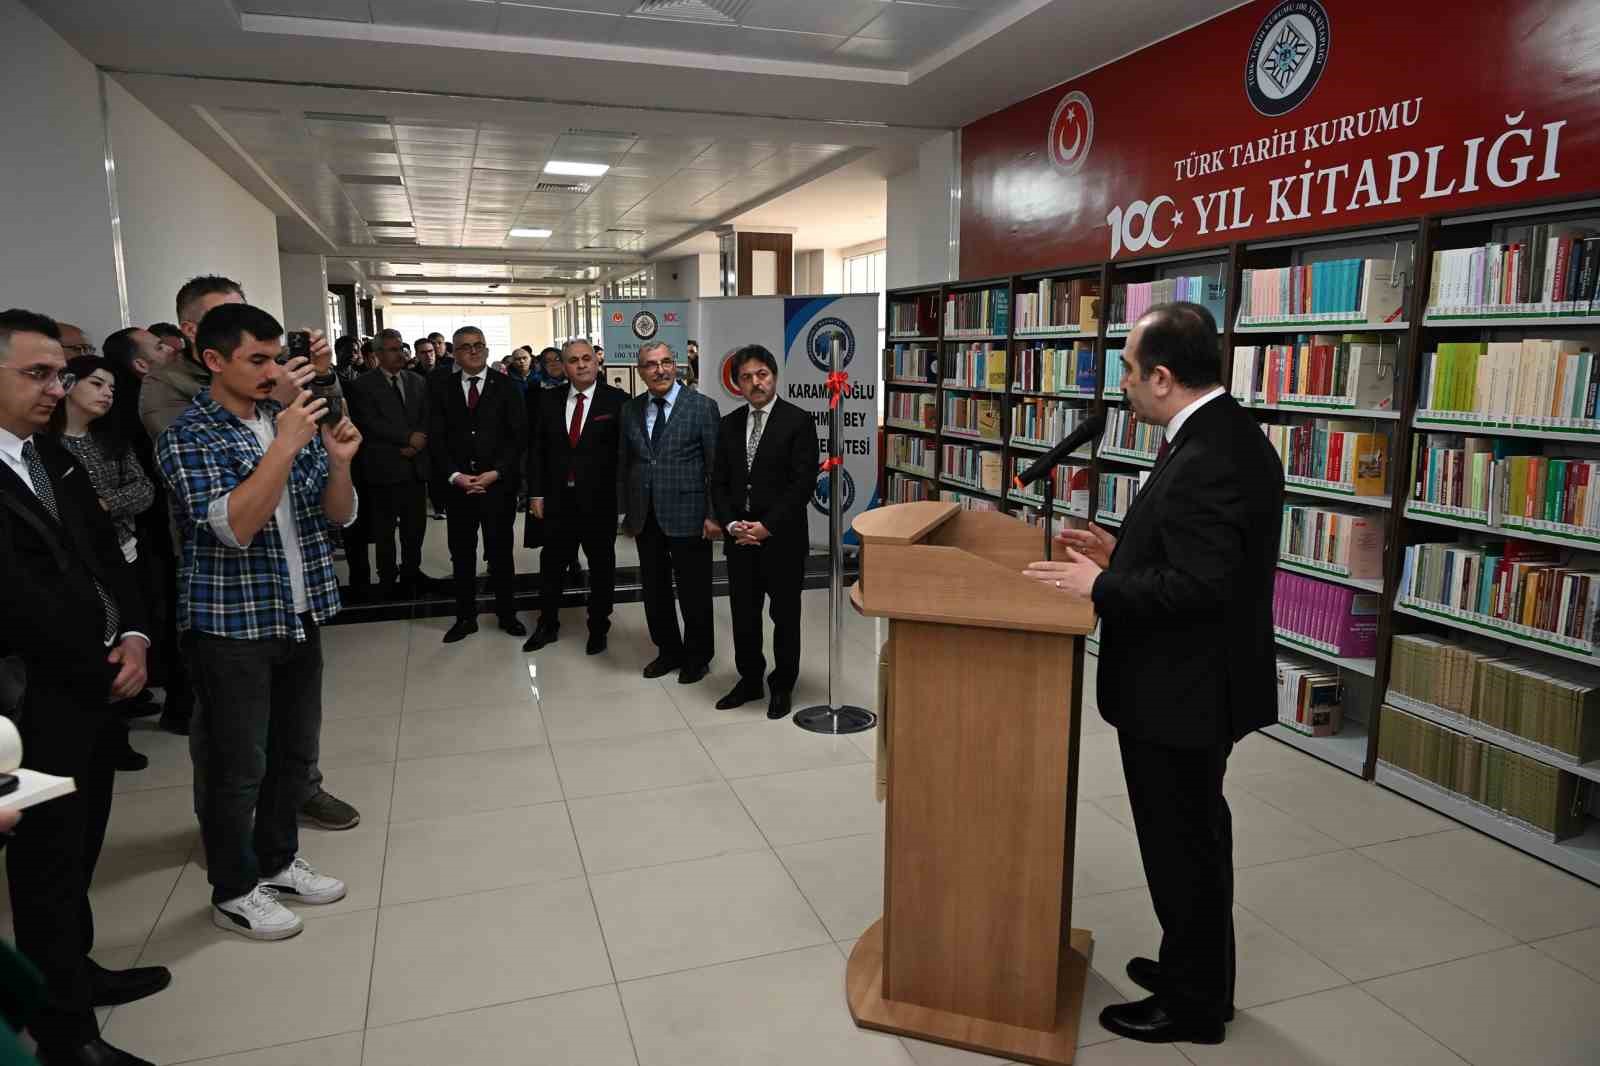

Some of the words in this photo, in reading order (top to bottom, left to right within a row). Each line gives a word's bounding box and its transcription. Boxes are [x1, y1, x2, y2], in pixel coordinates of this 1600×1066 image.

[1174, 149, 1225, 181] TÜRK
[1229, 129, 1297, 168] TARİH
[1302, 96, 1423, 151] KURUMU
[1191, 187, 1254, 235] YIL
[1265, 110, 1567, 224] KİTAPLIĞI
[788, 381, 875, 399] KARAMOĞLU
